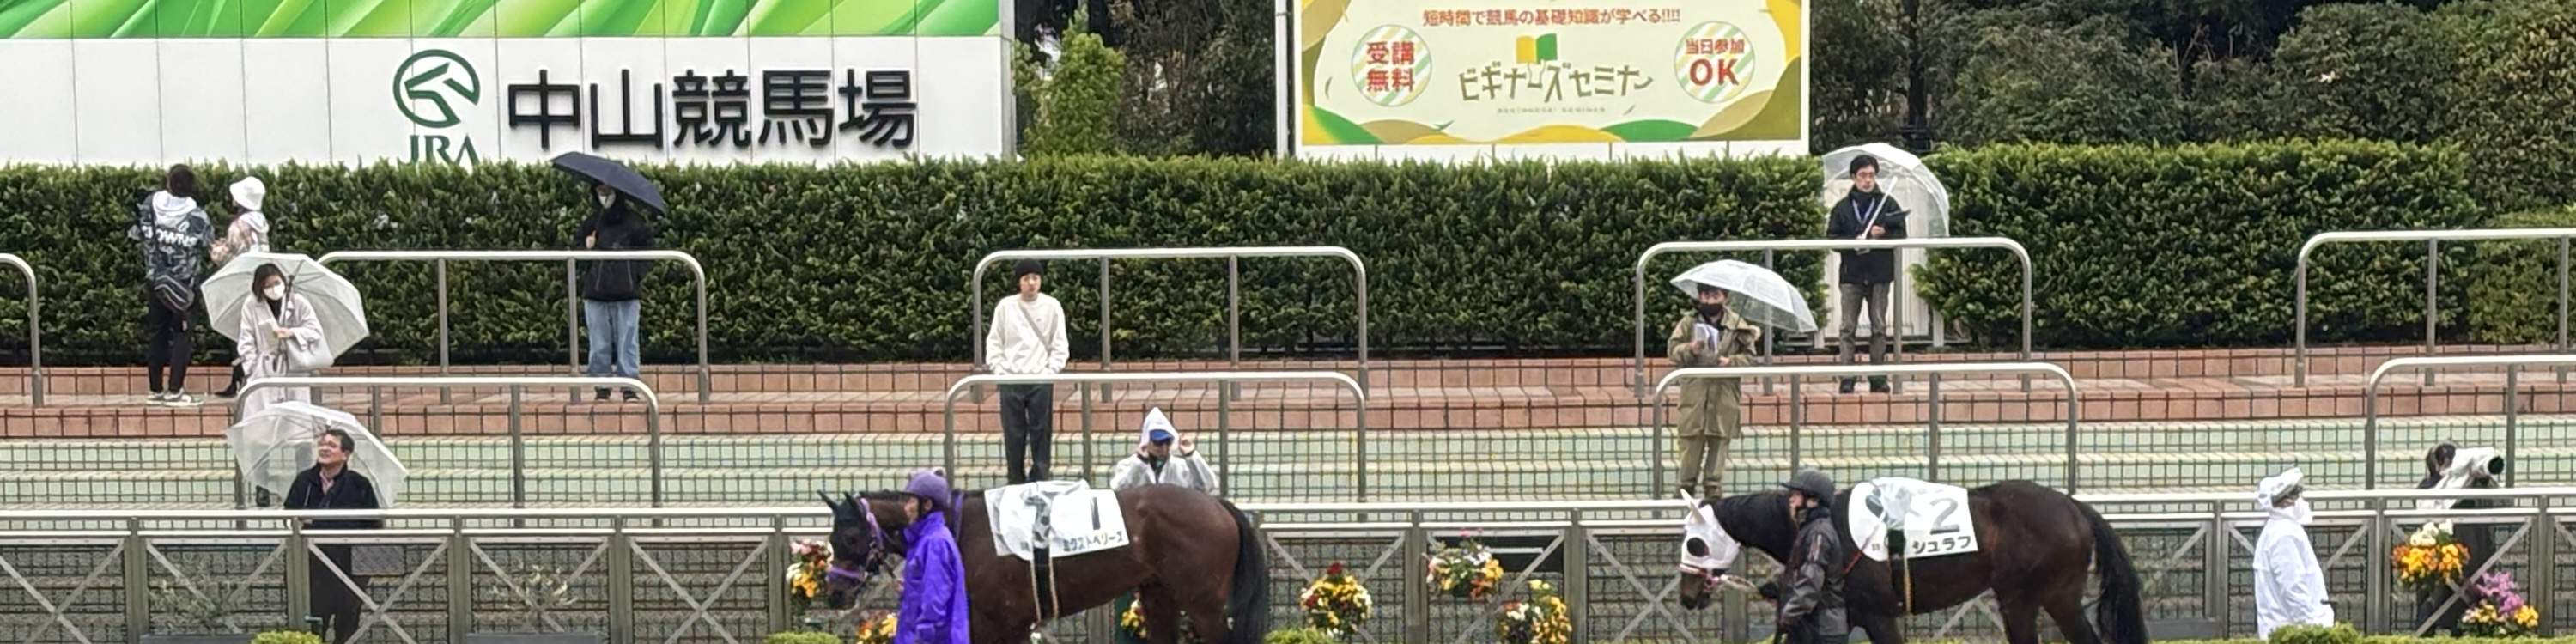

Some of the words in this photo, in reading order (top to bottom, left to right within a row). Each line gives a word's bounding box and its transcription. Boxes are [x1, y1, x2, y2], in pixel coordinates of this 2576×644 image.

[1366, 41, 1414, 65] 受講
[1686, 39, 1745, 55] 当日参加
[1366, 68, 1415, 92] 無料
[1689, 58, 1739, 86] OK
[507, 69, 918, 150] 中山競馬場
[398, 133, 480, 166] JRA
[1091, 496, 1101, 531] 1
[1929, 497, 1960, 536] 2
[1912, 535, 1971, 555] シュラフ
